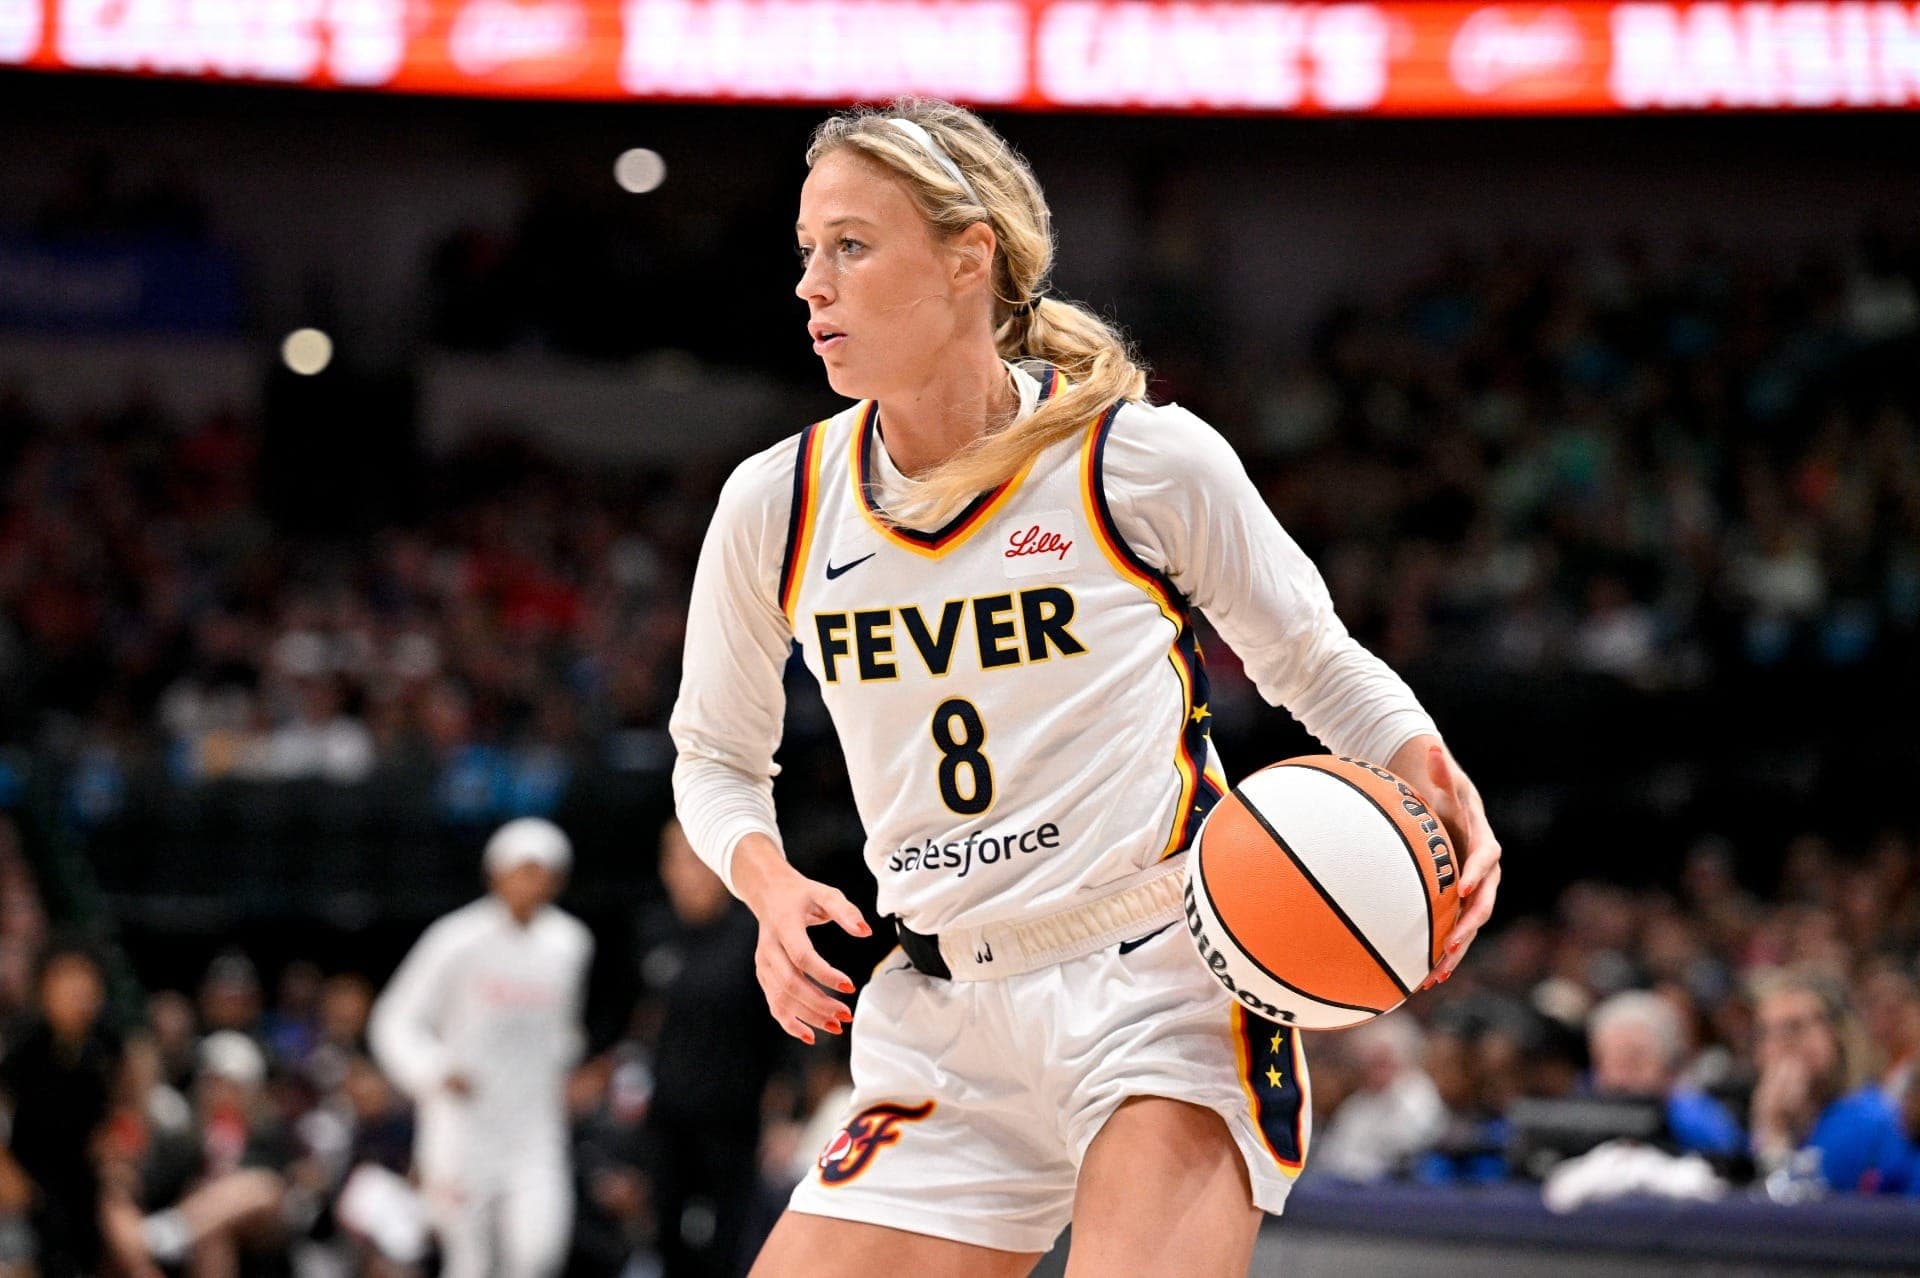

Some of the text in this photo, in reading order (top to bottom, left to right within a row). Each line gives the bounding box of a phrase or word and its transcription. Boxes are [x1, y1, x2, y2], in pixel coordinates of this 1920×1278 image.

[1005, 525, 1073, 561] Lilly
[814, 585, 1090, 684] FEVER
[931, 695, 997, 819] 8
